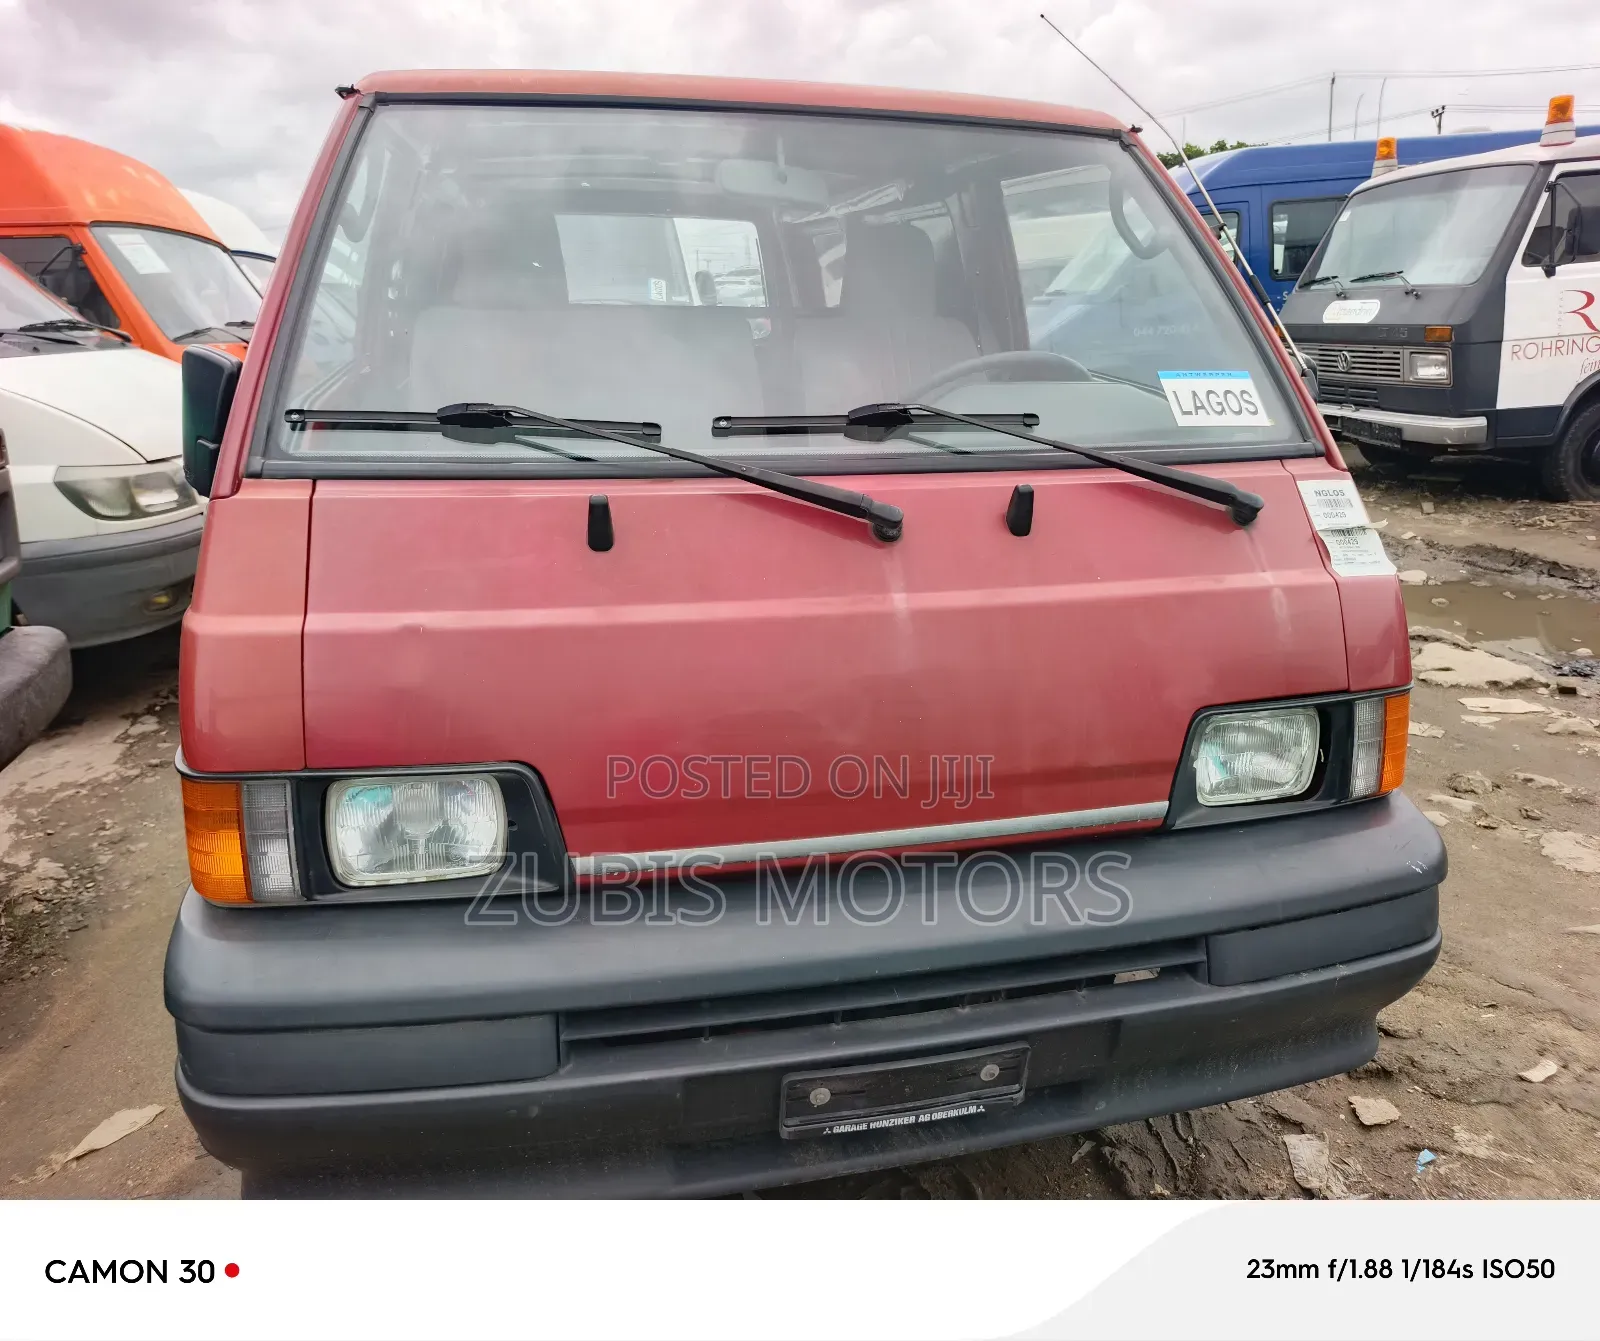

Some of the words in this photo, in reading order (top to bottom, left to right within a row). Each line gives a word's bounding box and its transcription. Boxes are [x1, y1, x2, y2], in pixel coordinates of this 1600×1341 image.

[1172, 389, 1259, 416] LAGOS
[833, 1123, 868, 1133] GARAGE
[870, 1116, 915, 1129] HUNZIKER
[918, 1113, 931, 1123] AG
[932, 1105, 977, 1120] OBERKULM
